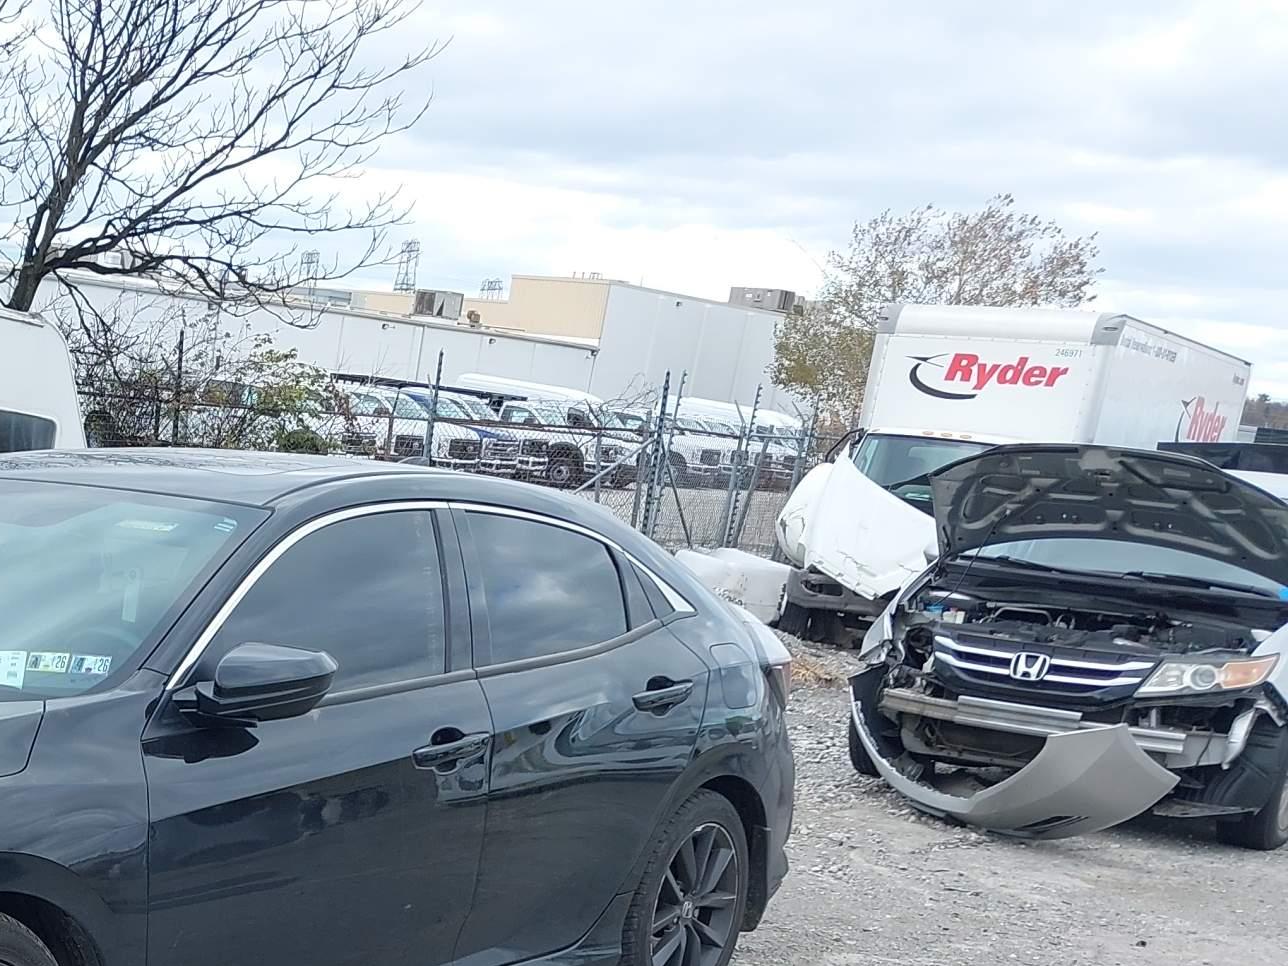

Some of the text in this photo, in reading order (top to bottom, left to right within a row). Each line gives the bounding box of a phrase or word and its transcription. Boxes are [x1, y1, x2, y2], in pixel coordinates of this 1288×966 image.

[1055, 348, 1083, 358] 246971
[944, 353, 1069, 390] Ryder
[1187, 395, 1228, 442] Ryder
[55, 655, 67, 669] 26
[97, 658, 110, 672] 26
